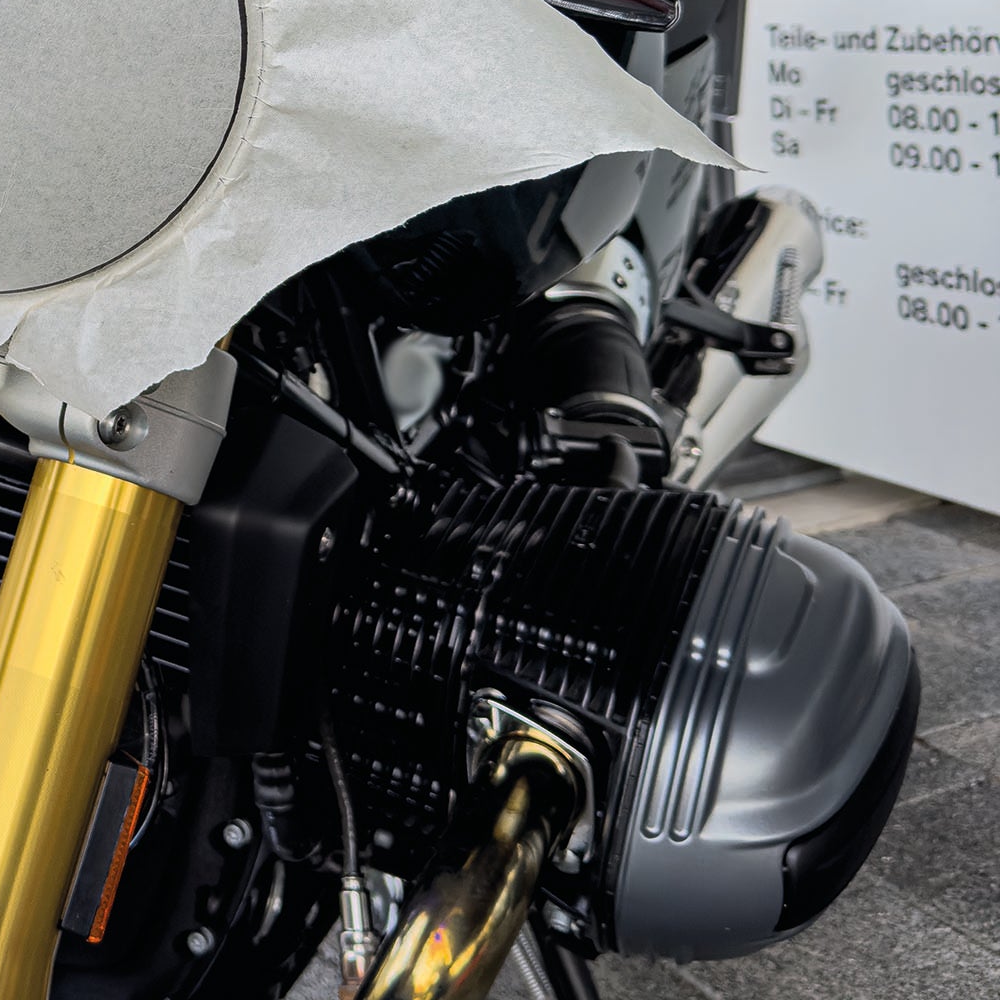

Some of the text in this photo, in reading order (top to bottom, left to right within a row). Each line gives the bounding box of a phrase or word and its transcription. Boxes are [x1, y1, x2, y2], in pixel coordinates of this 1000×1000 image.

[834, 25, 877, 51] und
[885, 24, 1000, 53] Zubehör
[769, 61, 800, 85] Mo
[770, 96, 791, 120] Di
[815, 99, 837, 122] Fr
[889, 104, 959, 133] 08.00
[772, 131, 800, 155] Sa
[891, 142, 961, 173] 09.00
[897, 263, 1000, 297] geschlo
[826, 281, 846, 306] Fr
[898, 295, 969, 330] 08.00
